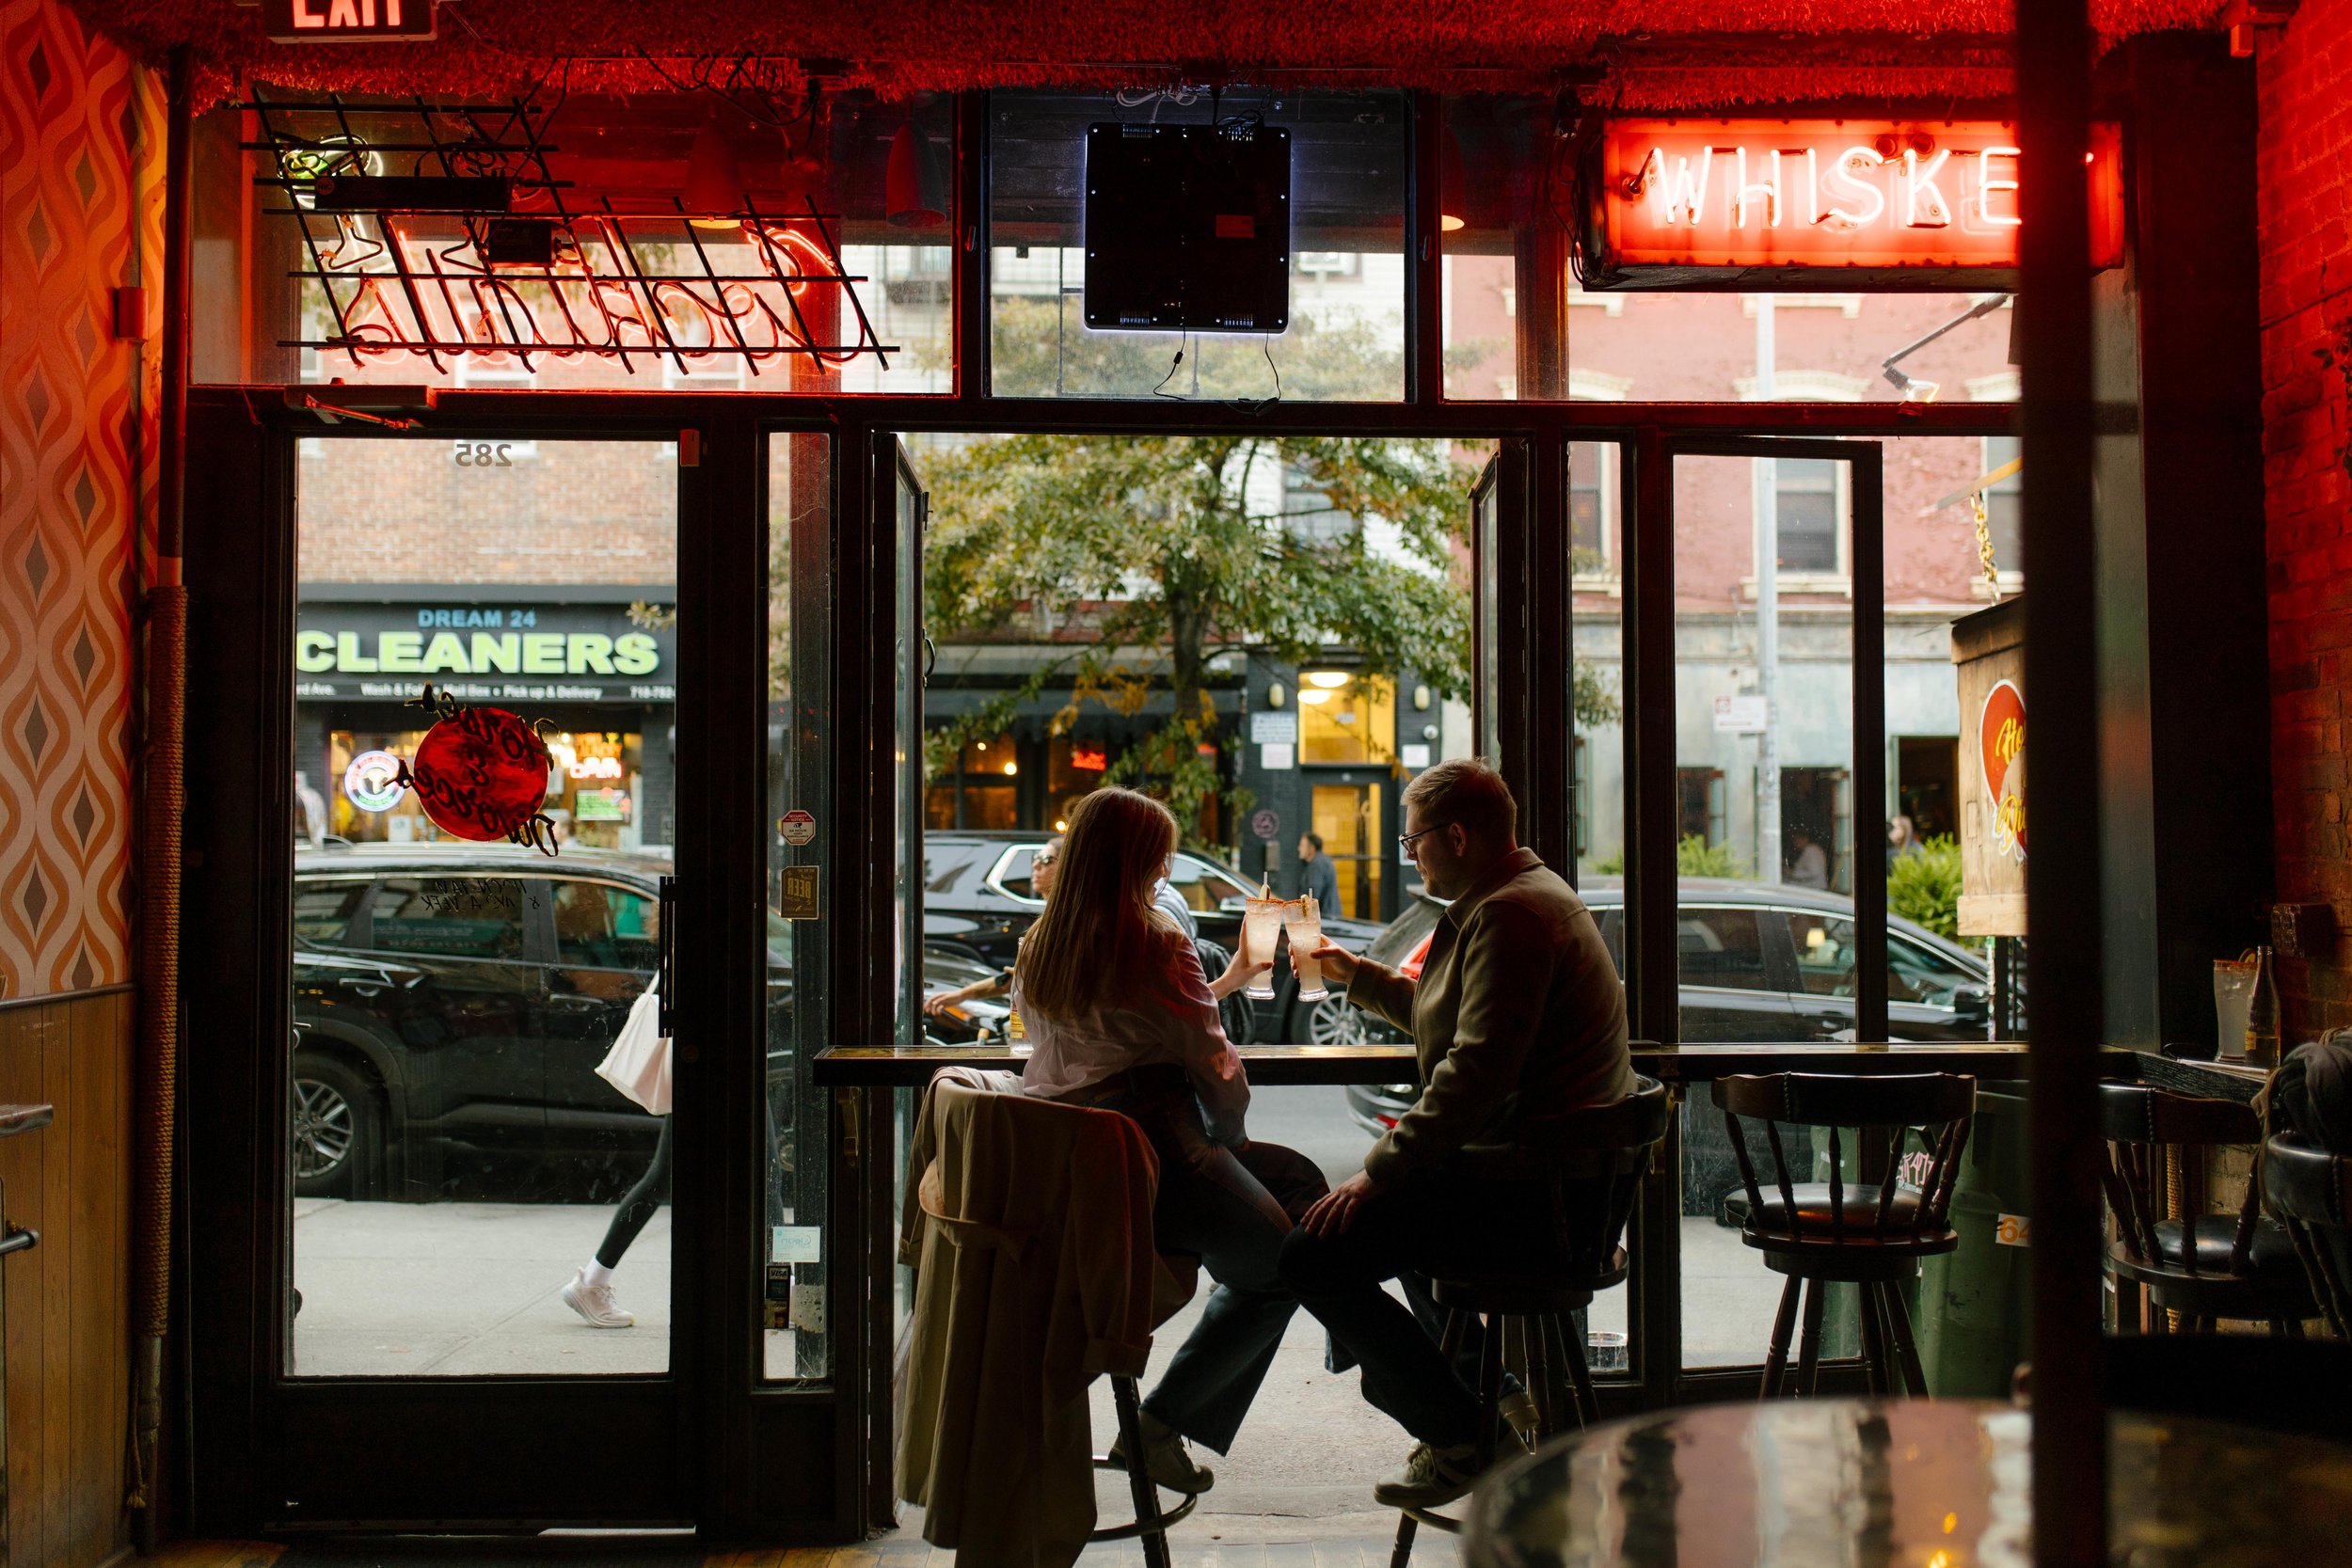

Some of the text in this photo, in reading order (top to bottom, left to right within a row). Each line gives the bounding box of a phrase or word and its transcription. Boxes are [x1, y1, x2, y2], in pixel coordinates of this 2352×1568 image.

[1653, 146, 2024, 229] WHISKE
[418, 609, 537, 628] DREAM 24
[296, 630, 660, 675] CLEANERS
[360, 682, 393, 696] Wash
[393, 683, 404, 696] &
[503, 684, 602, 701] Pick up & Delivery
[1995, 718, 2026, 766] Ho
